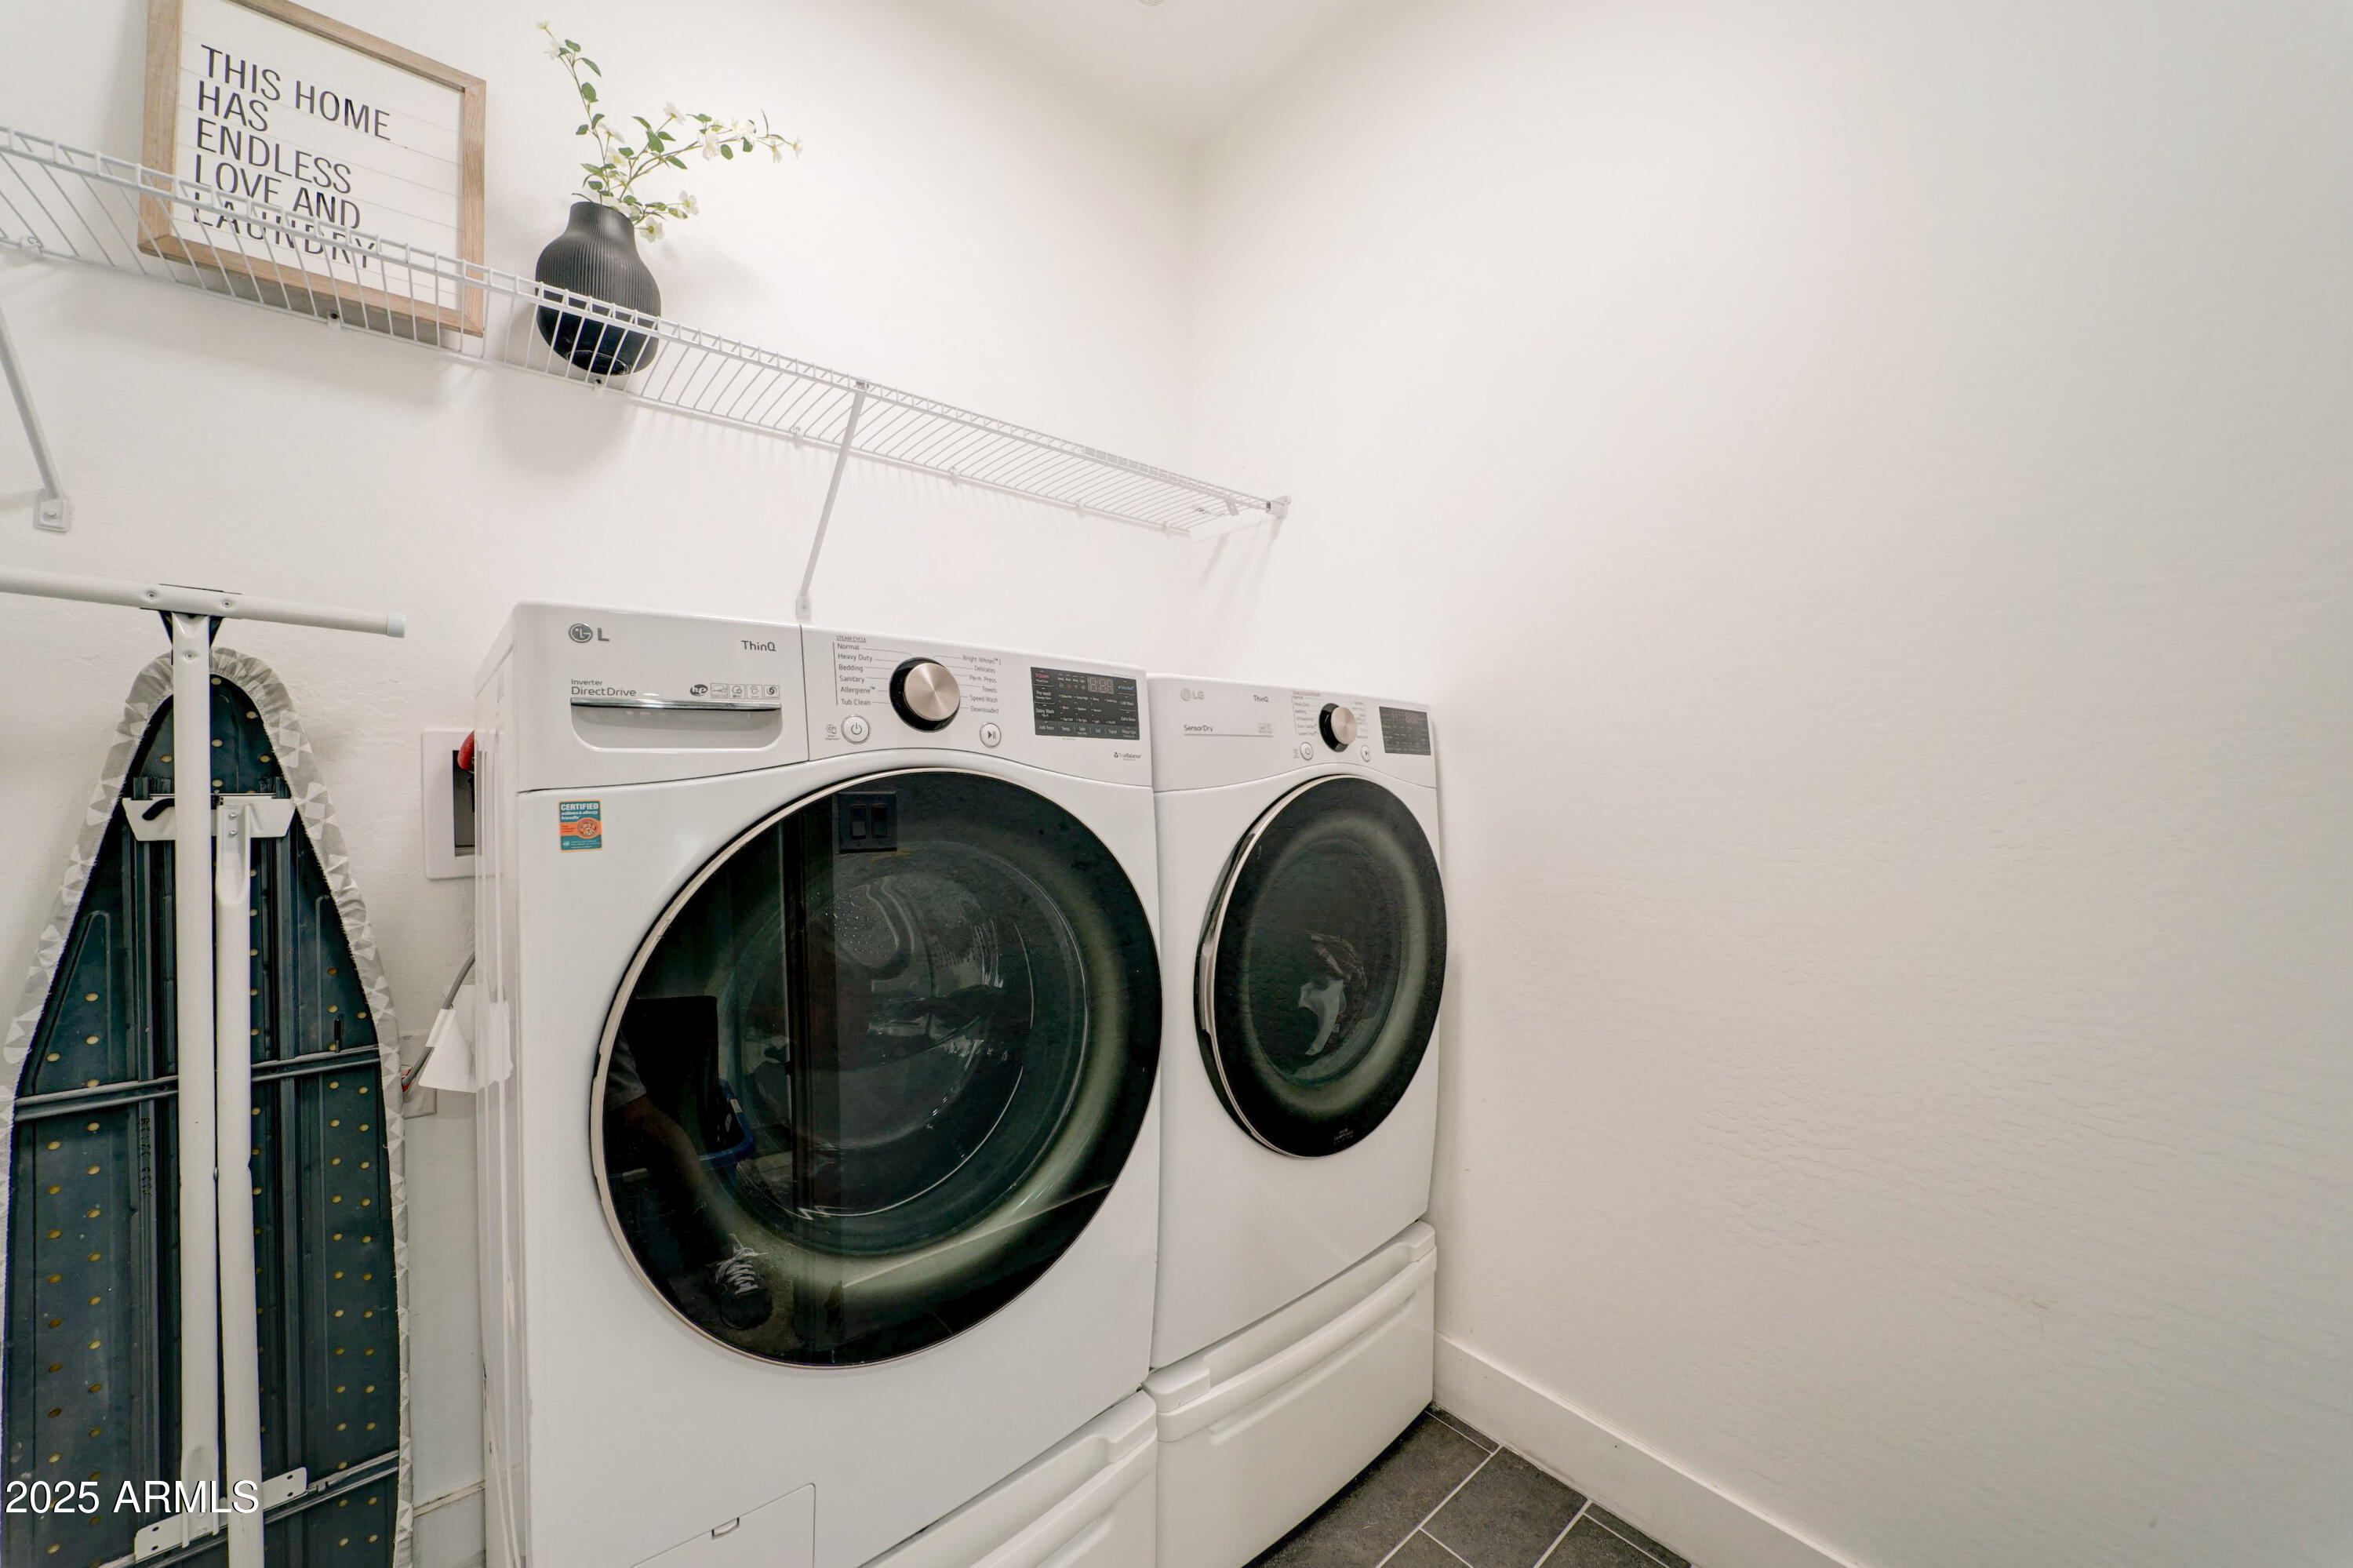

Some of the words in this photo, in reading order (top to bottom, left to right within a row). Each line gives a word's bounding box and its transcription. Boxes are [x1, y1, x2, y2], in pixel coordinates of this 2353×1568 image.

[202, 45, 280, 100] THIS
[296, 80, 391, 140] HOME
[198, 80, 268, 132] HAS
[198, 118, 351, 194] ENDLESS
[196, 155, 282, 206] LOVE
[293, 187, 360, 229] AND
[740, 640, 776, 652] ThinQ
[859, 653, 872, 662] Duty
[962, 654, 977, 663] Bright
[838, 664, 864, 673] Bedding
[974, 665, 996, 674] Delicates
[839, 675, 864, 684] Sanitary
[1191, 690, 1205, 700] LG
[561, 802, 598, 811] CERTIFIED
